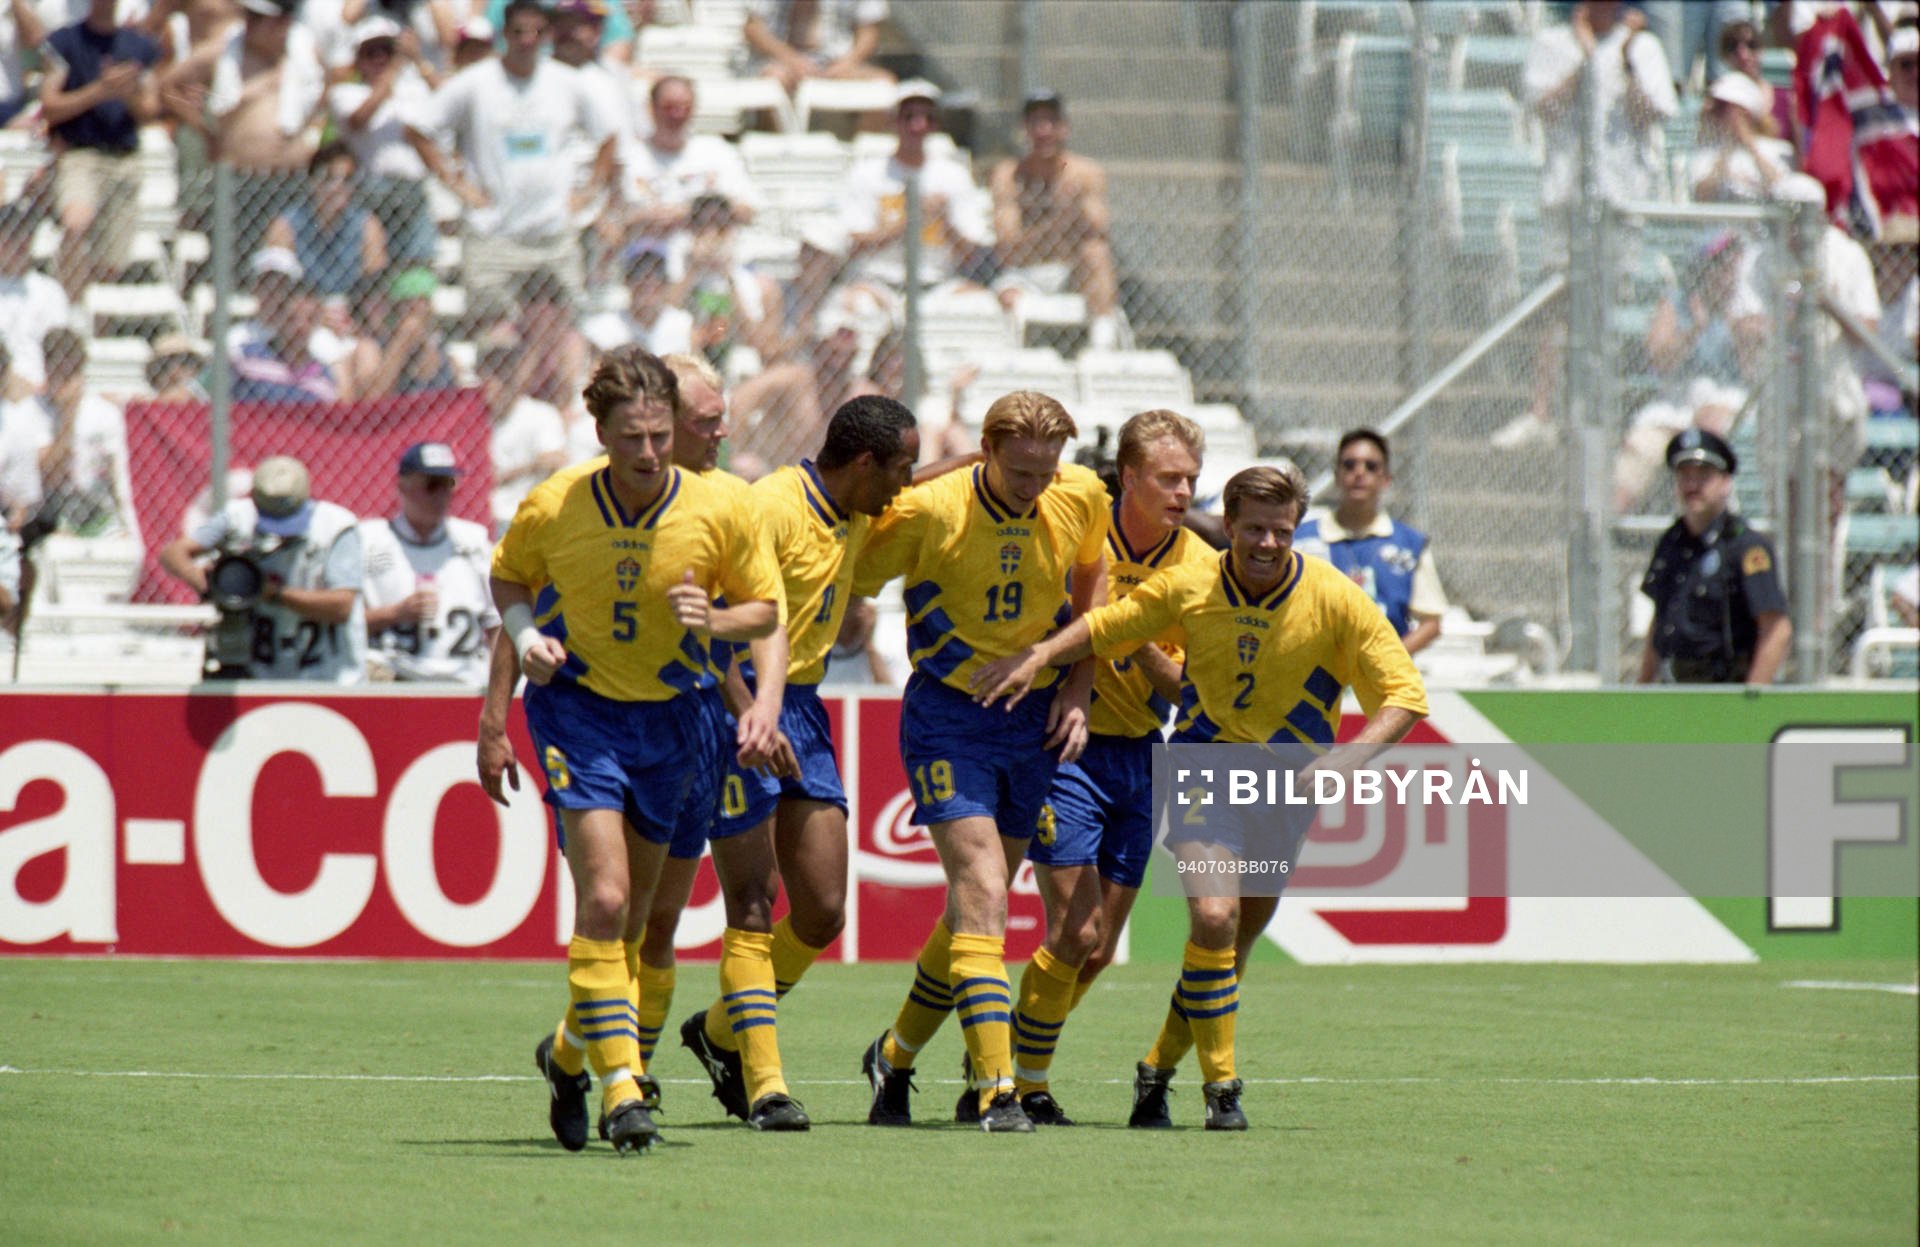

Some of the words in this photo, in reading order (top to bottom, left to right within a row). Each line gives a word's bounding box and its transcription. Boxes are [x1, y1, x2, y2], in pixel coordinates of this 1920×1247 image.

[612, 600, 638, 643] 5
[983, 581, 1023, 622] 19
[1232, 672, 1255, 710] 2
[915, 759, 955, 805] 19
[0, 702, 728, 949] a-Co
[1183, 786, 1207, 825] 2
[1766, 722, 1913, 935] F
